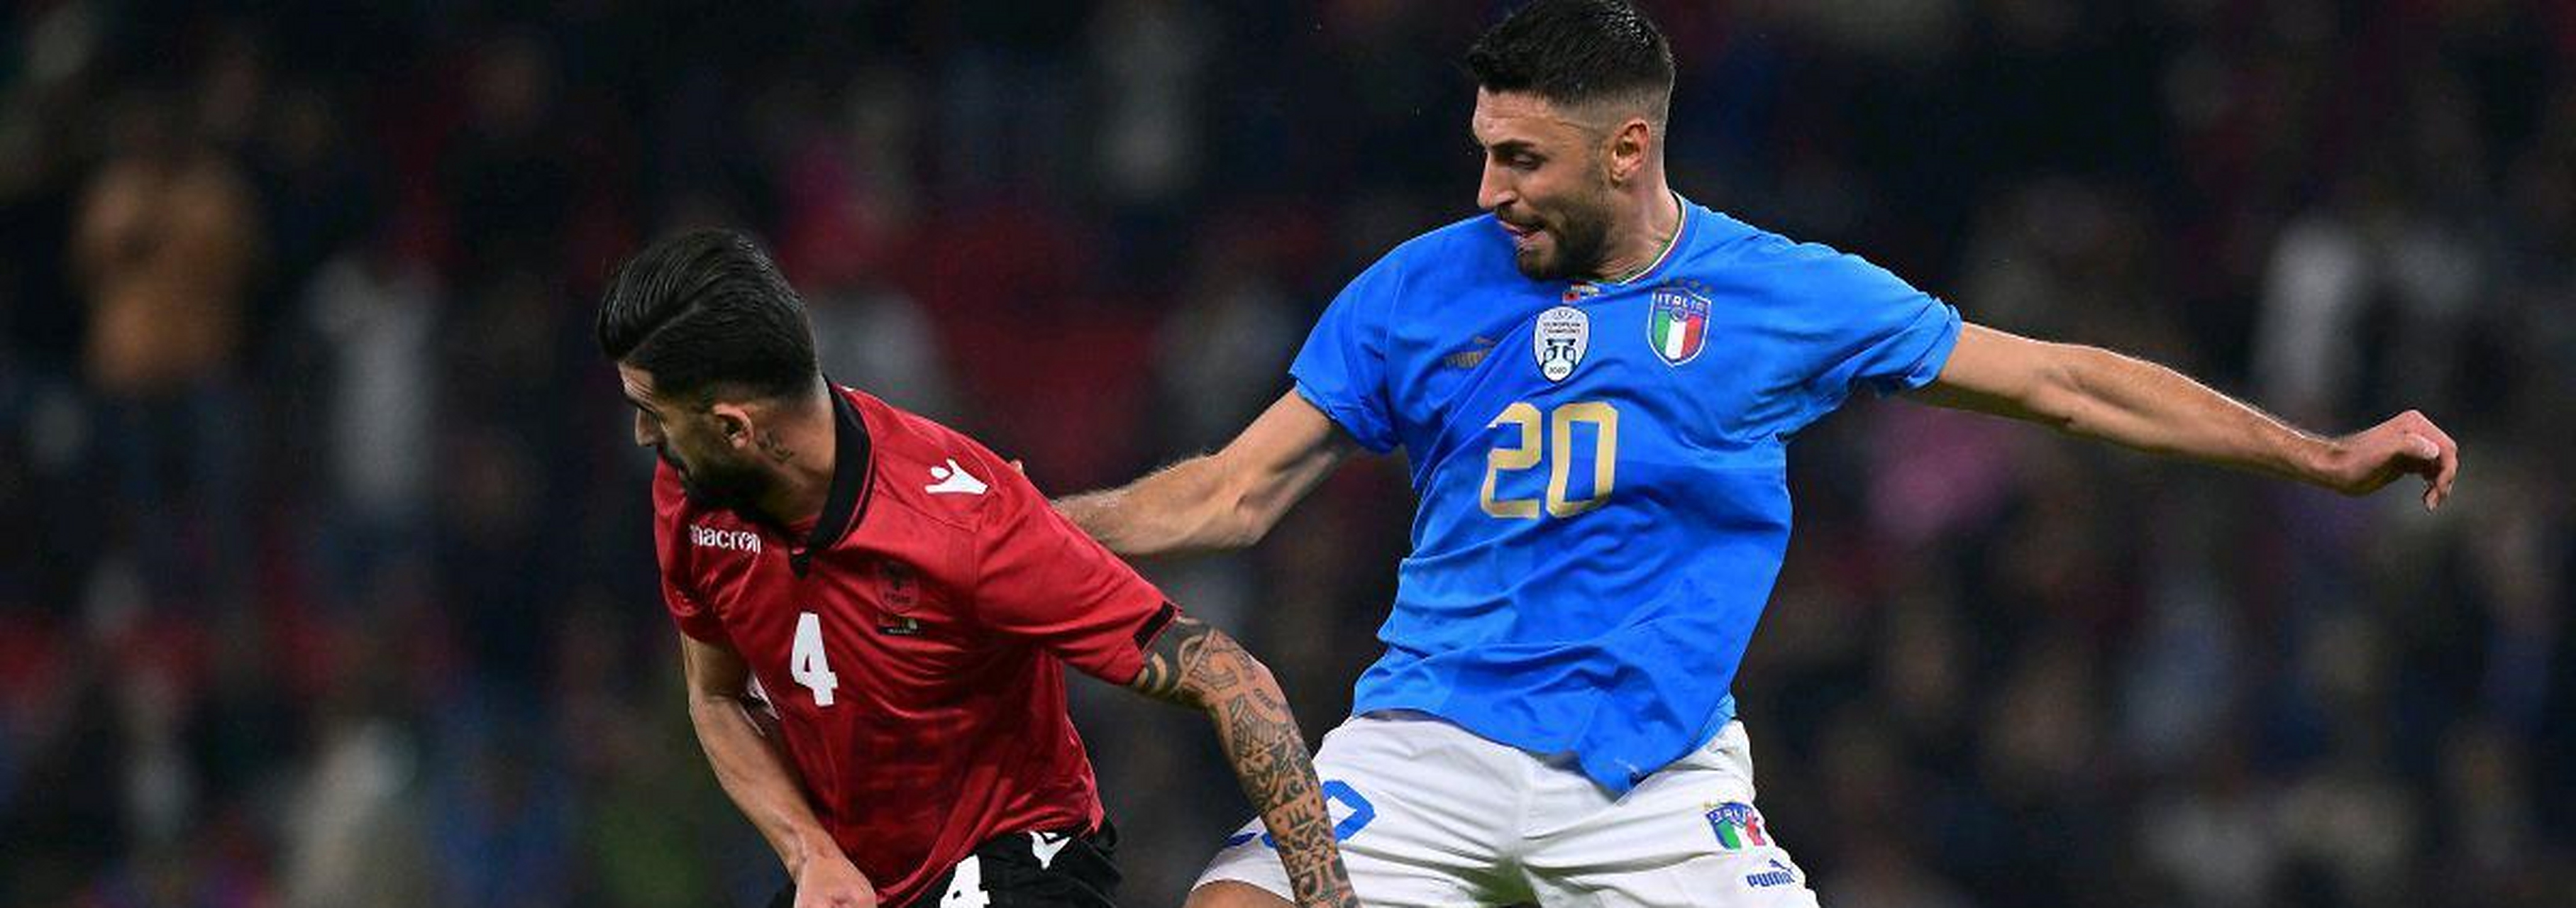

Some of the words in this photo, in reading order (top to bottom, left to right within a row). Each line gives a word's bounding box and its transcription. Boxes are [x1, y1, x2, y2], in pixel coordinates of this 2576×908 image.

[1481, 401, 1619, 520] 20
[791, 610, 839, 707] 4
[939, 853, 991, 908] 4
